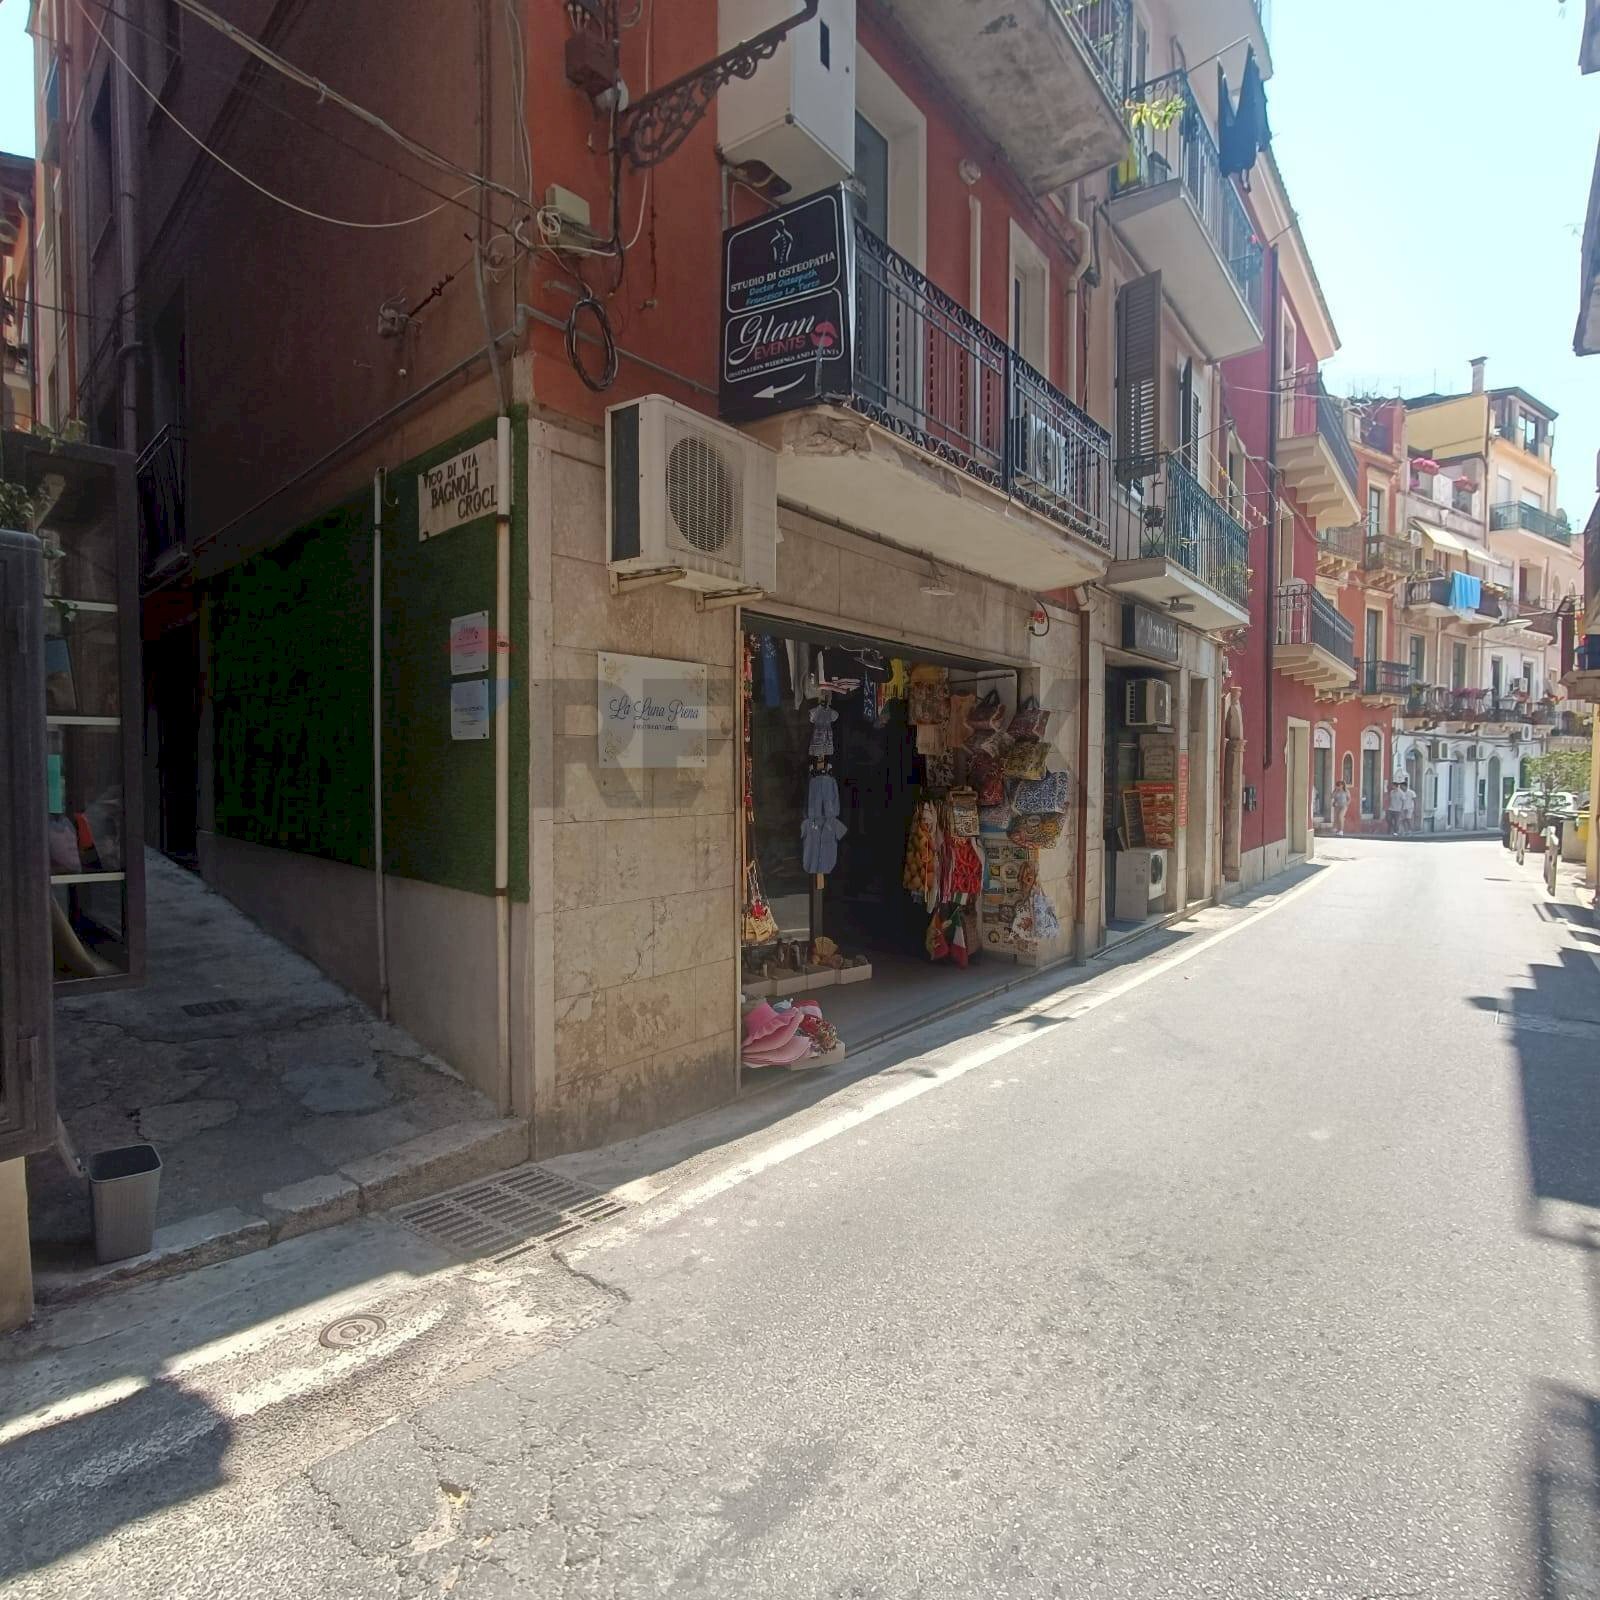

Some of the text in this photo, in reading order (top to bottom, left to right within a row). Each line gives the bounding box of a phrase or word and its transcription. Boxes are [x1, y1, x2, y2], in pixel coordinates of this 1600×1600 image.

[730, 251, 836, 293] STUDIO DI OSTEOPATIA
[728, 314, 815, 365] Glam
[754, 335, 806, 360] EVENTS
[796, 351, 810, 360] AND
[422, 453, 478, 490] VICO DI VIA
[431, 467, 479, 510] BAGNOLI
[608, 694, 700, 722] La Luna Piena
